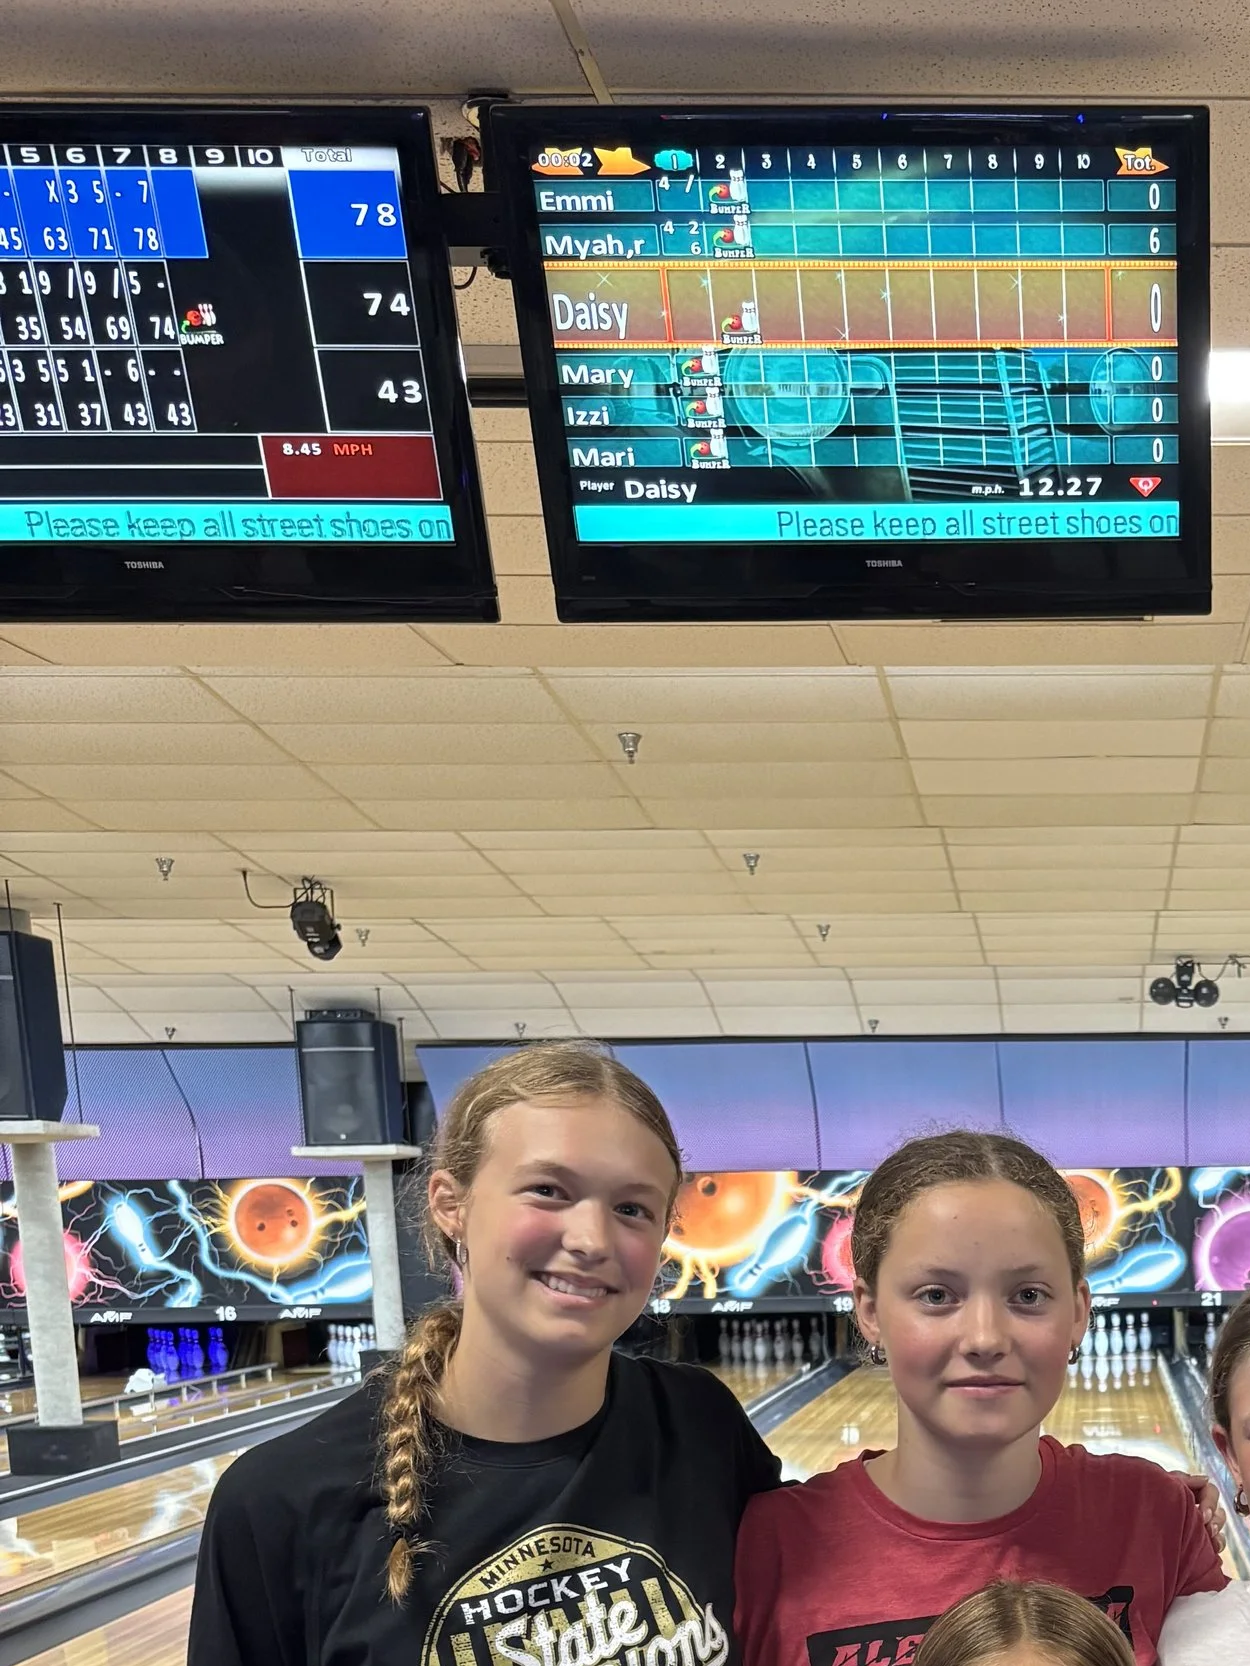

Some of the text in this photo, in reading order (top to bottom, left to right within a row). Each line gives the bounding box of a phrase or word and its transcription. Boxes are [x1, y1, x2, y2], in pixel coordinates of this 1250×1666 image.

[20, 147, 353, 165] 5 6 7 8 9 10 Total
[537, 151, 1157, 172] 00:02 1 2 3 4 5 6 7 8 9 10 Tot.
[540, 175, 1161, 212] Emmi 4 0
[710, 203, 751, 214] BUMPER
[43, 226, 69, 251] 63
[88, 226, 114, 251] 71
[133, 226, 160, 251] 78
[350, 202, 398, 227] 78
[545, 220, 1161, 261] Myah,r 4 2 6
[691, 241, 702, 256] 6
[714, 247, 755, 259] BUMPER
[15, 291, 411, 341] 35 54 69 74 74
[552, 282, 1163, 341] Daisy 0
[179, 332, 225, 346] BUMPER
[722, 334, 763, 345] BUMPER
[561, 355, 1164, 390] Mary 0
[682, 377, 723, 388] BUMPER
[34, 402, 61, 427] 31
[77, 402, 102, 427] 37
[123, 402, 149, 427] 43
[167, 402, 193, 427] 43
[377, 379, 423, 404] 43
[567, 397, 1164, 427] Izzi 0
[687, 418, 727, 429] BUMPER
[282, 442, 374, 456] 8.45 MPH
[572, 437, 1165, 468] Mari 0
[691, 459, 731, 470] BUMPER
[579, 476, 1103, 504] Player Daisy m.p.h. 12.27
[24, 509, 450, 540] Please keep all street shoes on
[777, 508, 1178, 538] Please keep all street shoes on
[124, 560, 165, 570] TOSHIBA
[865, 559, 903, 568] TOSHIBA
[711, 1300, 754, 1313] AMF
[1201, 1291, 1222, 1307] 21
[89, 1306, 323, 1324] AMF 16 AMF
[479, 1536, 597, 1591] MINNESOTA
[460, 1557, 633, 1626] HOCKEY
